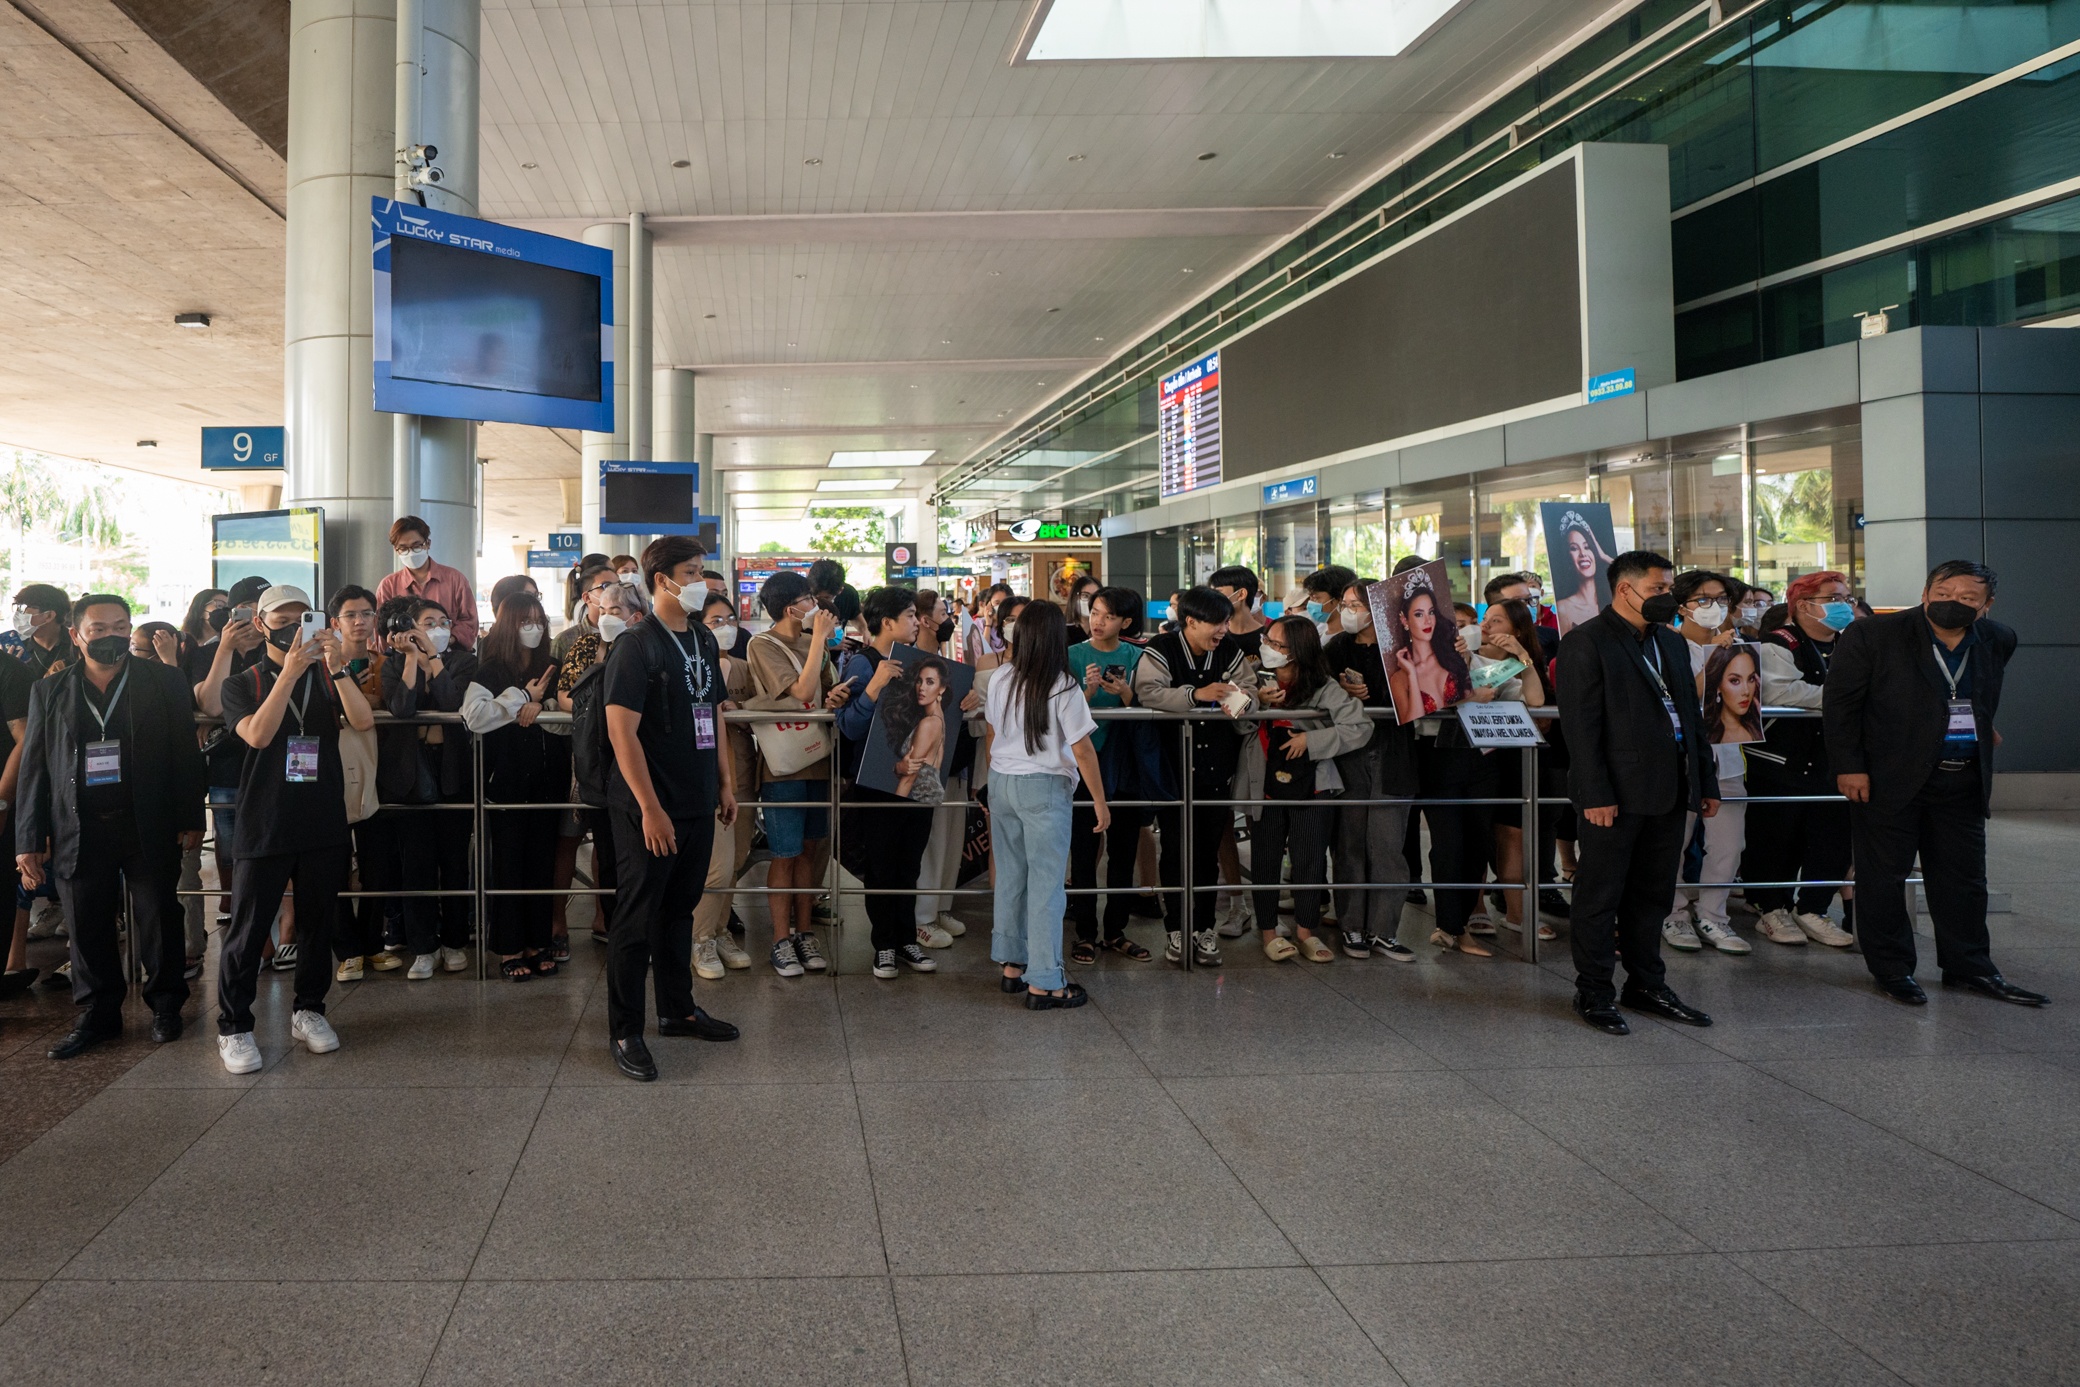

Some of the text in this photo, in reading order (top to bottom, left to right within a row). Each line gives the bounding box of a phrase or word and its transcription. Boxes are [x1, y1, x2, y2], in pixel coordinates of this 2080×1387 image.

[396, 222, 521, 258] LUCKY STAR media
[233, 432, 279, 463] 9 GF
[1302, 479, 1314, 494] A2
[556, 535, 573, 547] 10
[685, 664, 712, 698] MISS UNIVERSE
